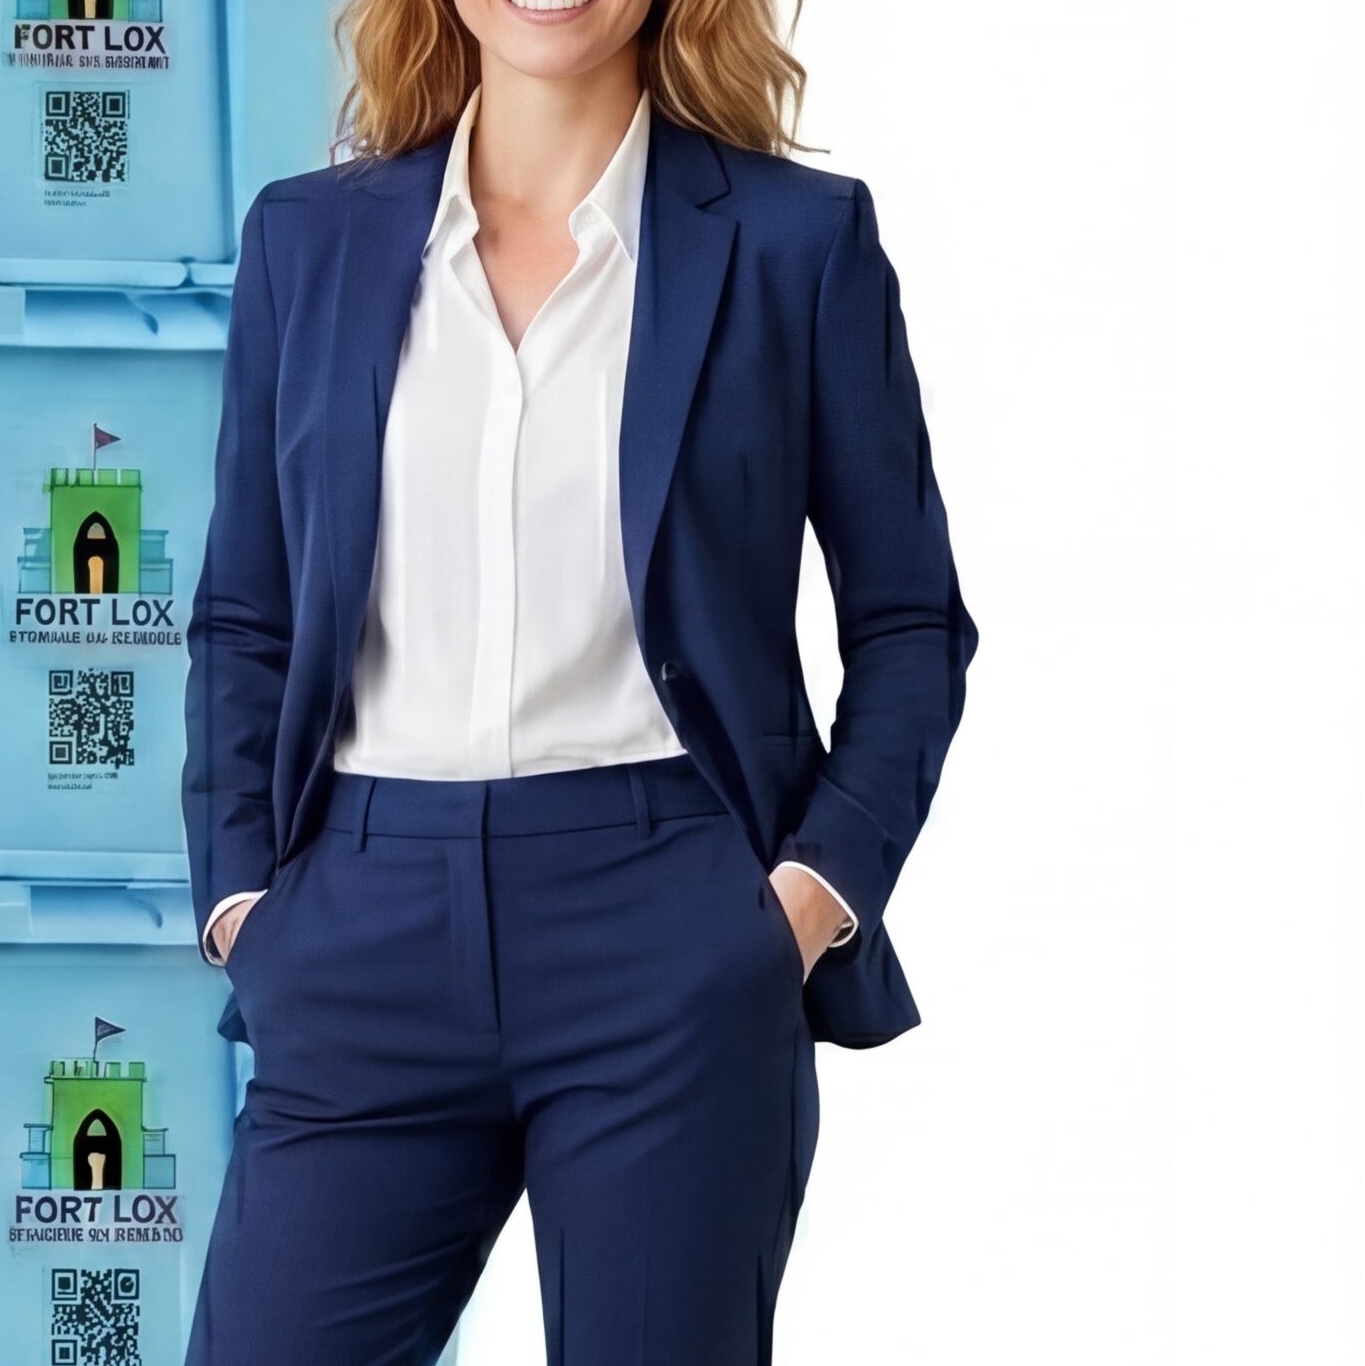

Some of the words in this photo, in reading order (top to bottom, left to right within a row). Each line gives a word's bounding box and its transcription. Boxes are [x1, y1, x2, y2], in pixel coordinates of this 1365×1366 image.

[14, 24, 95, 50] FORT
[104, 26, 166, 54] LOX
[15, 598, 101, 626] FORT
[111, 598, 175, 627] LOX
[16, 1195, 103, 1224] FORT
[114, 1195, 179, 1224] LOX
